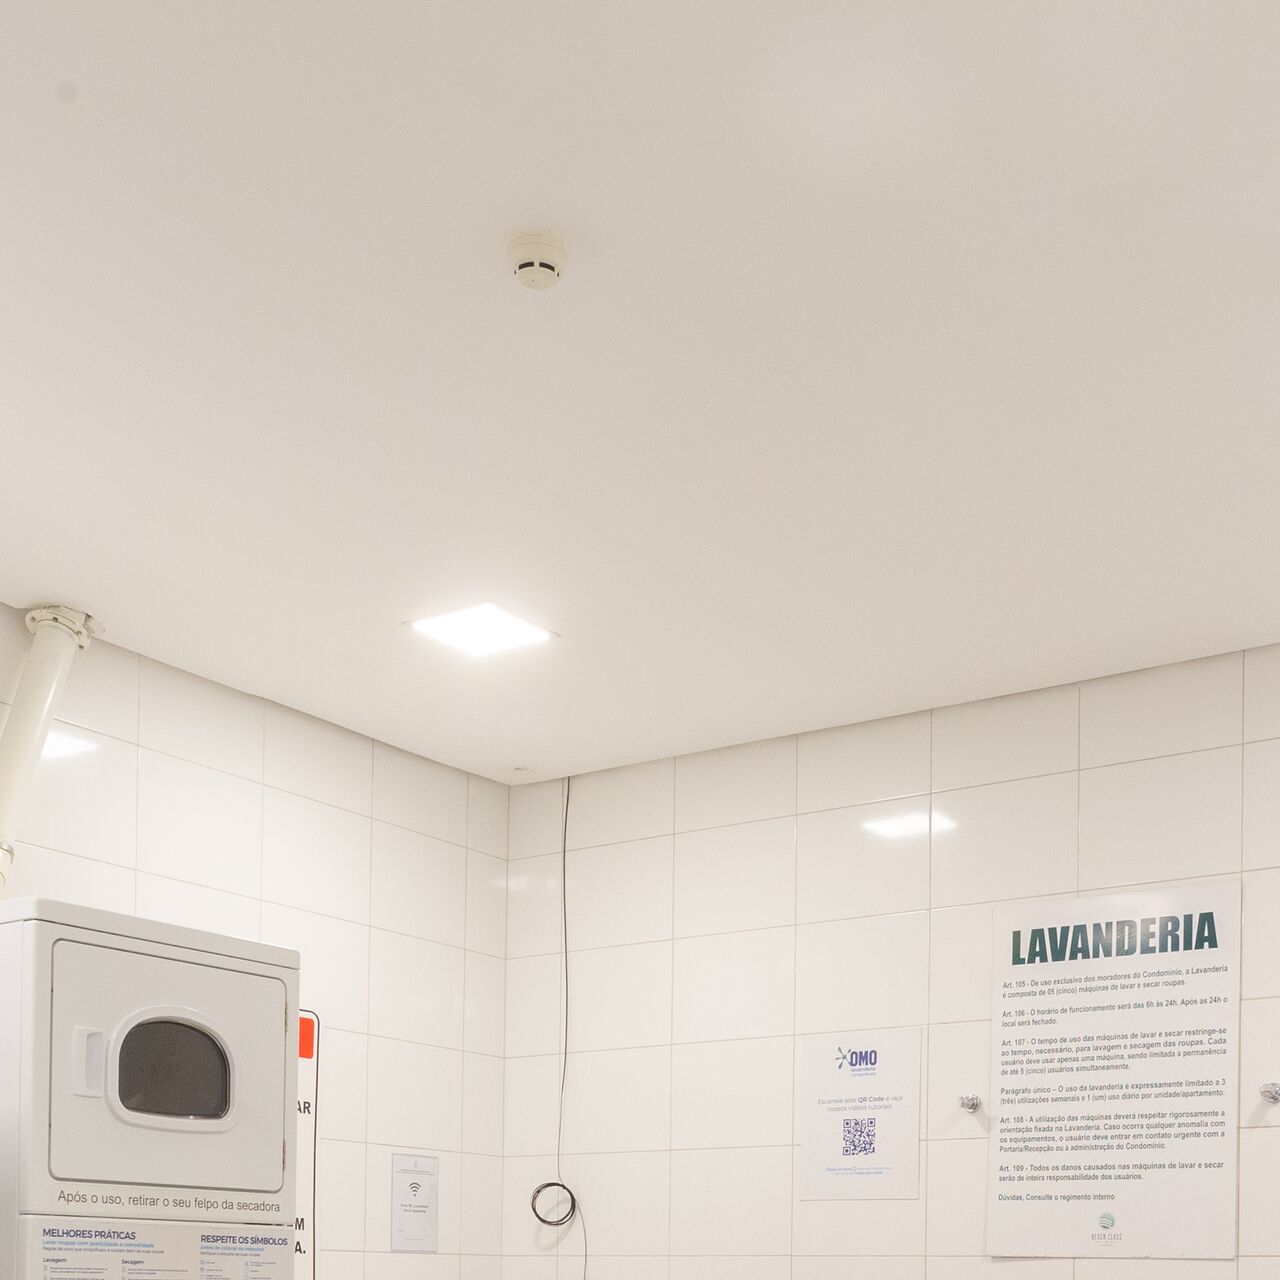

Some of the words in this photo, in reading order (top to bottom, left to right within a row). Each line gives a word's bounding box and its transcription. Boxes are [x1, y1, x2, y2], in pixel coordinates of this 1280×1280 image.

[1011, 911, 1218, 965] LAVANDERIA
[1053, 976, 1082, 984] exclusivo
[1084, 974, 1095, 982] dos
[1097, 972, 1131, 980] moradores
[1142, 968, 1182, 978] Condomínio,
[1191, 965, 1228, 973] Lavanderia
[1007, 989, 1037, 998] composta
[1056, 986, 1077, 996] (cinco)
[1079, 984, 1108, 993] máquinas
[1162, 980, 1186, 988] roupas.
[1038, 1036, 1057, 1045] tempo
[1096, 1033, 1128, 1042] máquinas
[1185, 1027, 1226, 1036] restringe-se
[849, 1050, 877, 1067] OMO
[1000, 1126, 1032, 1134] orientação
[1145, 1122, 1175, 1130] qualquer
[1132, 1162, 1165, 1170] máquinas
[58, 1191, 87, 1205] Após
[91, 1195, 98, 1203] o
[101, 1195, 124, 1207] uso,
[128, 1194, 160, 1206] retirar
[163, 1198, 169, 1206] o
[172, 1198, 191, 1207] seu
[194, 1197, 218, 1211] felpo
[221, 1198, 233, 1209] da
[237, 1198, 280, 1211] secadora
[42, 1228, 93, 1238] MELHORES
[94, 1229, 136, 1240] PRÁTICAS
[200, 1235, 238, 1244] RESPEITE
[238, 1236, 249, 1244] OS
[250, 1235, 288, 1245] SÍMBOLOS
